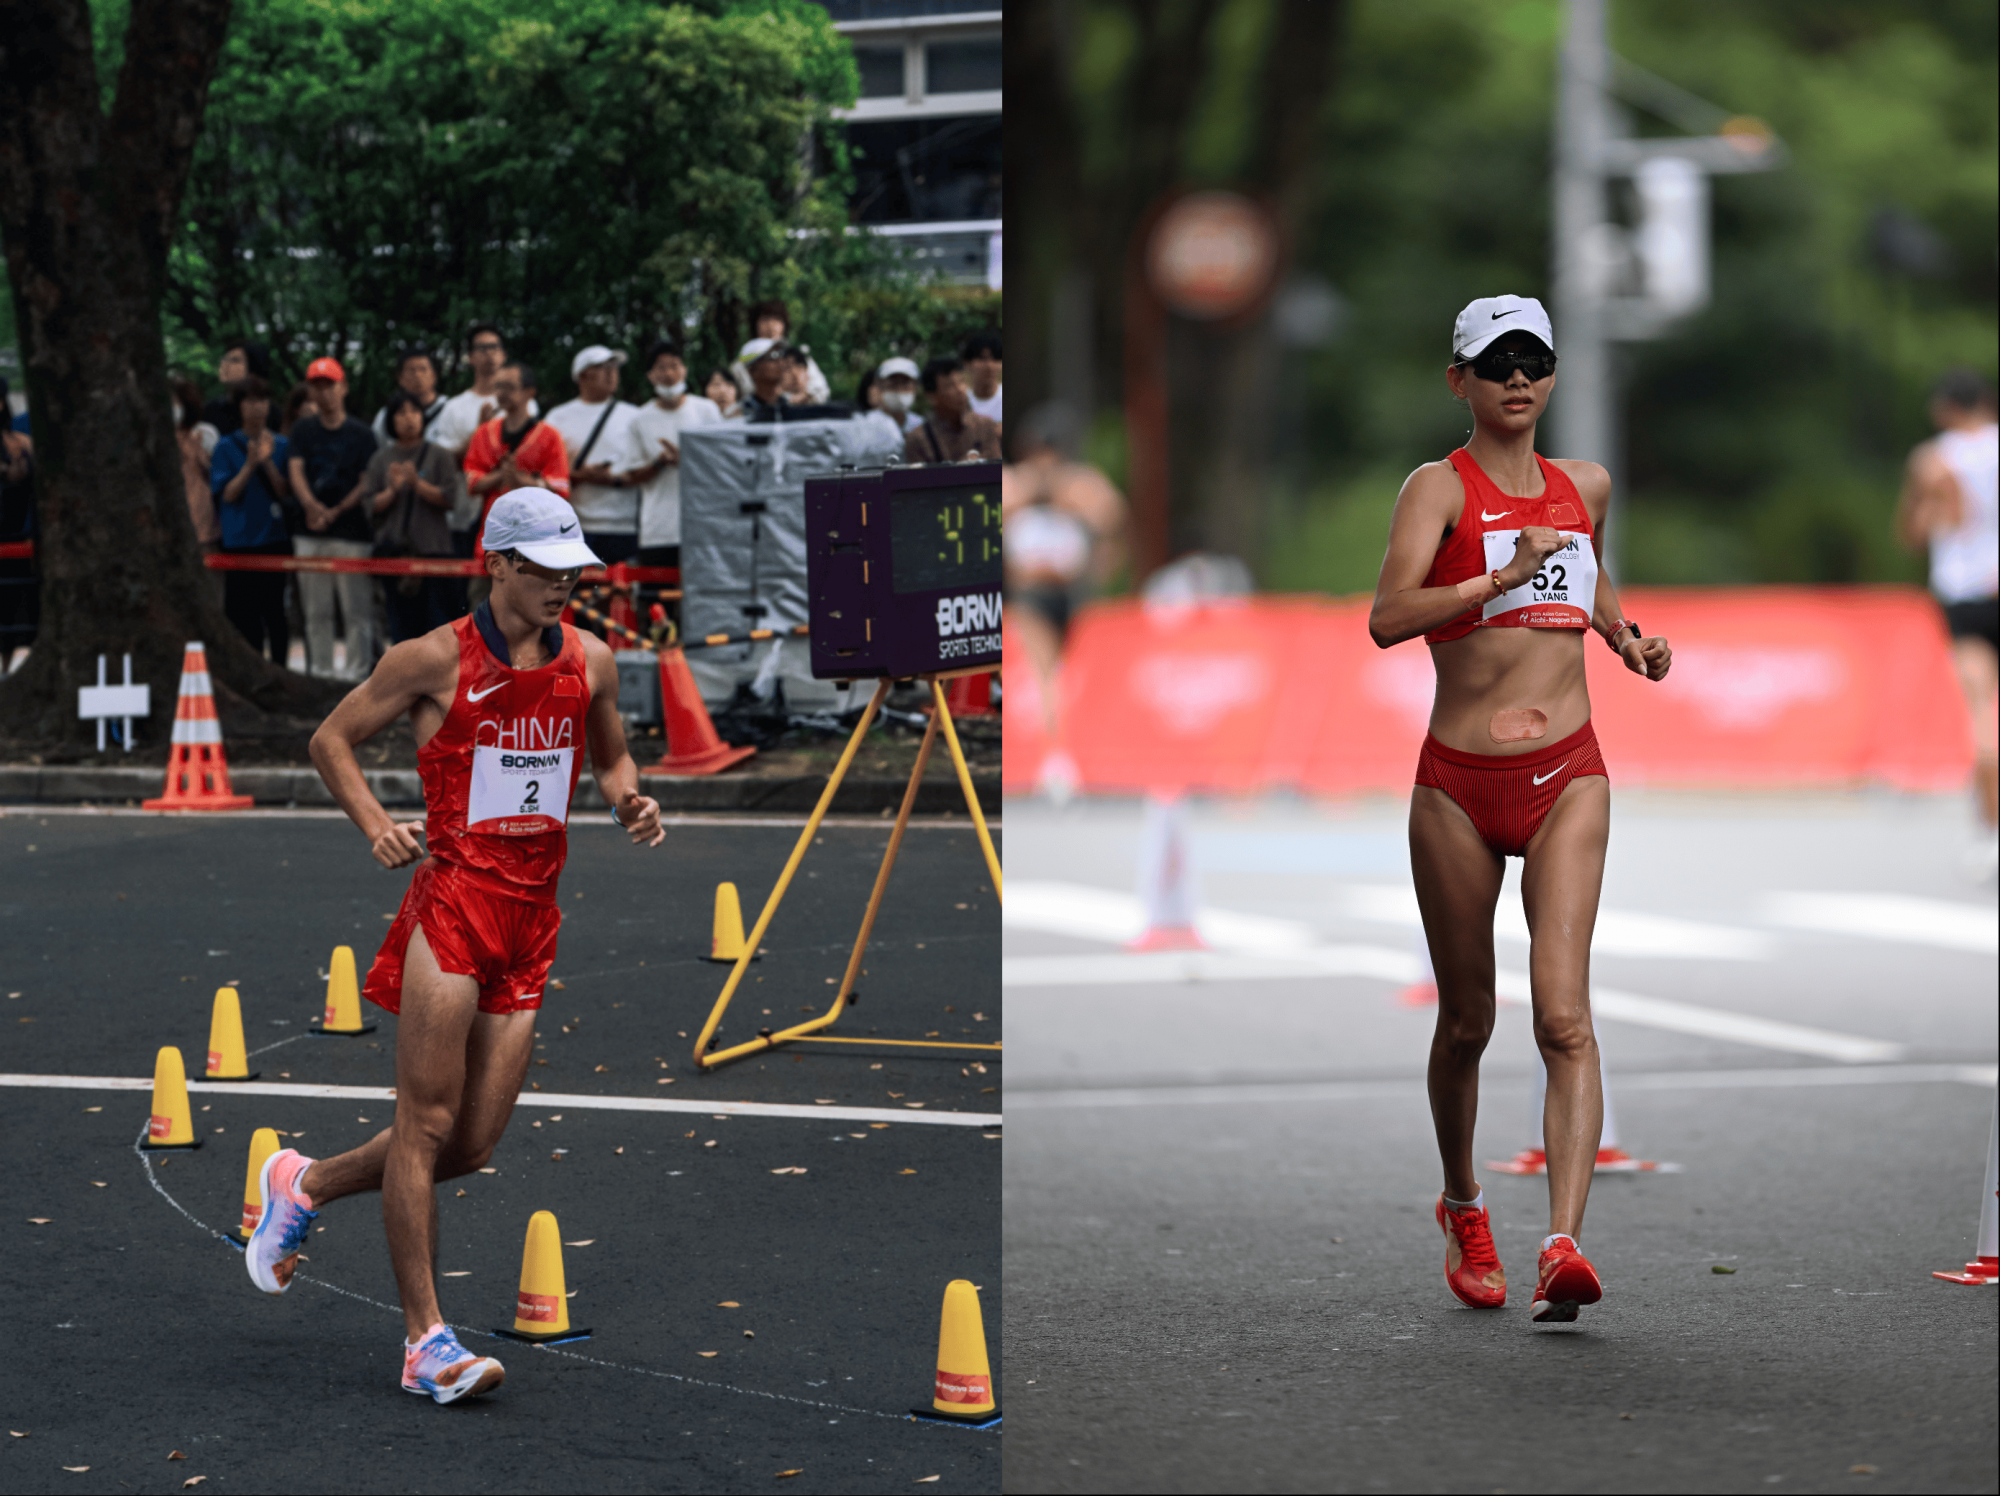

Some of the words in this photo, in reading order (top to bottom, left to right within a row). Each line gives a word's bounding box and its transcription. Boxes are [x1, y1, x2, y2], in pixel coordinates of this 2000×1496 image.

[1532, 564, 1568, 591] 52
[1533, 592, 1568, 601] L.YANG
[939, 638, 969, 659] SPORTS
[477, 717, 572, 750] CHINA
[500, 754, 560, 768] BORNAN
[524, 780, 539, 804] 2
